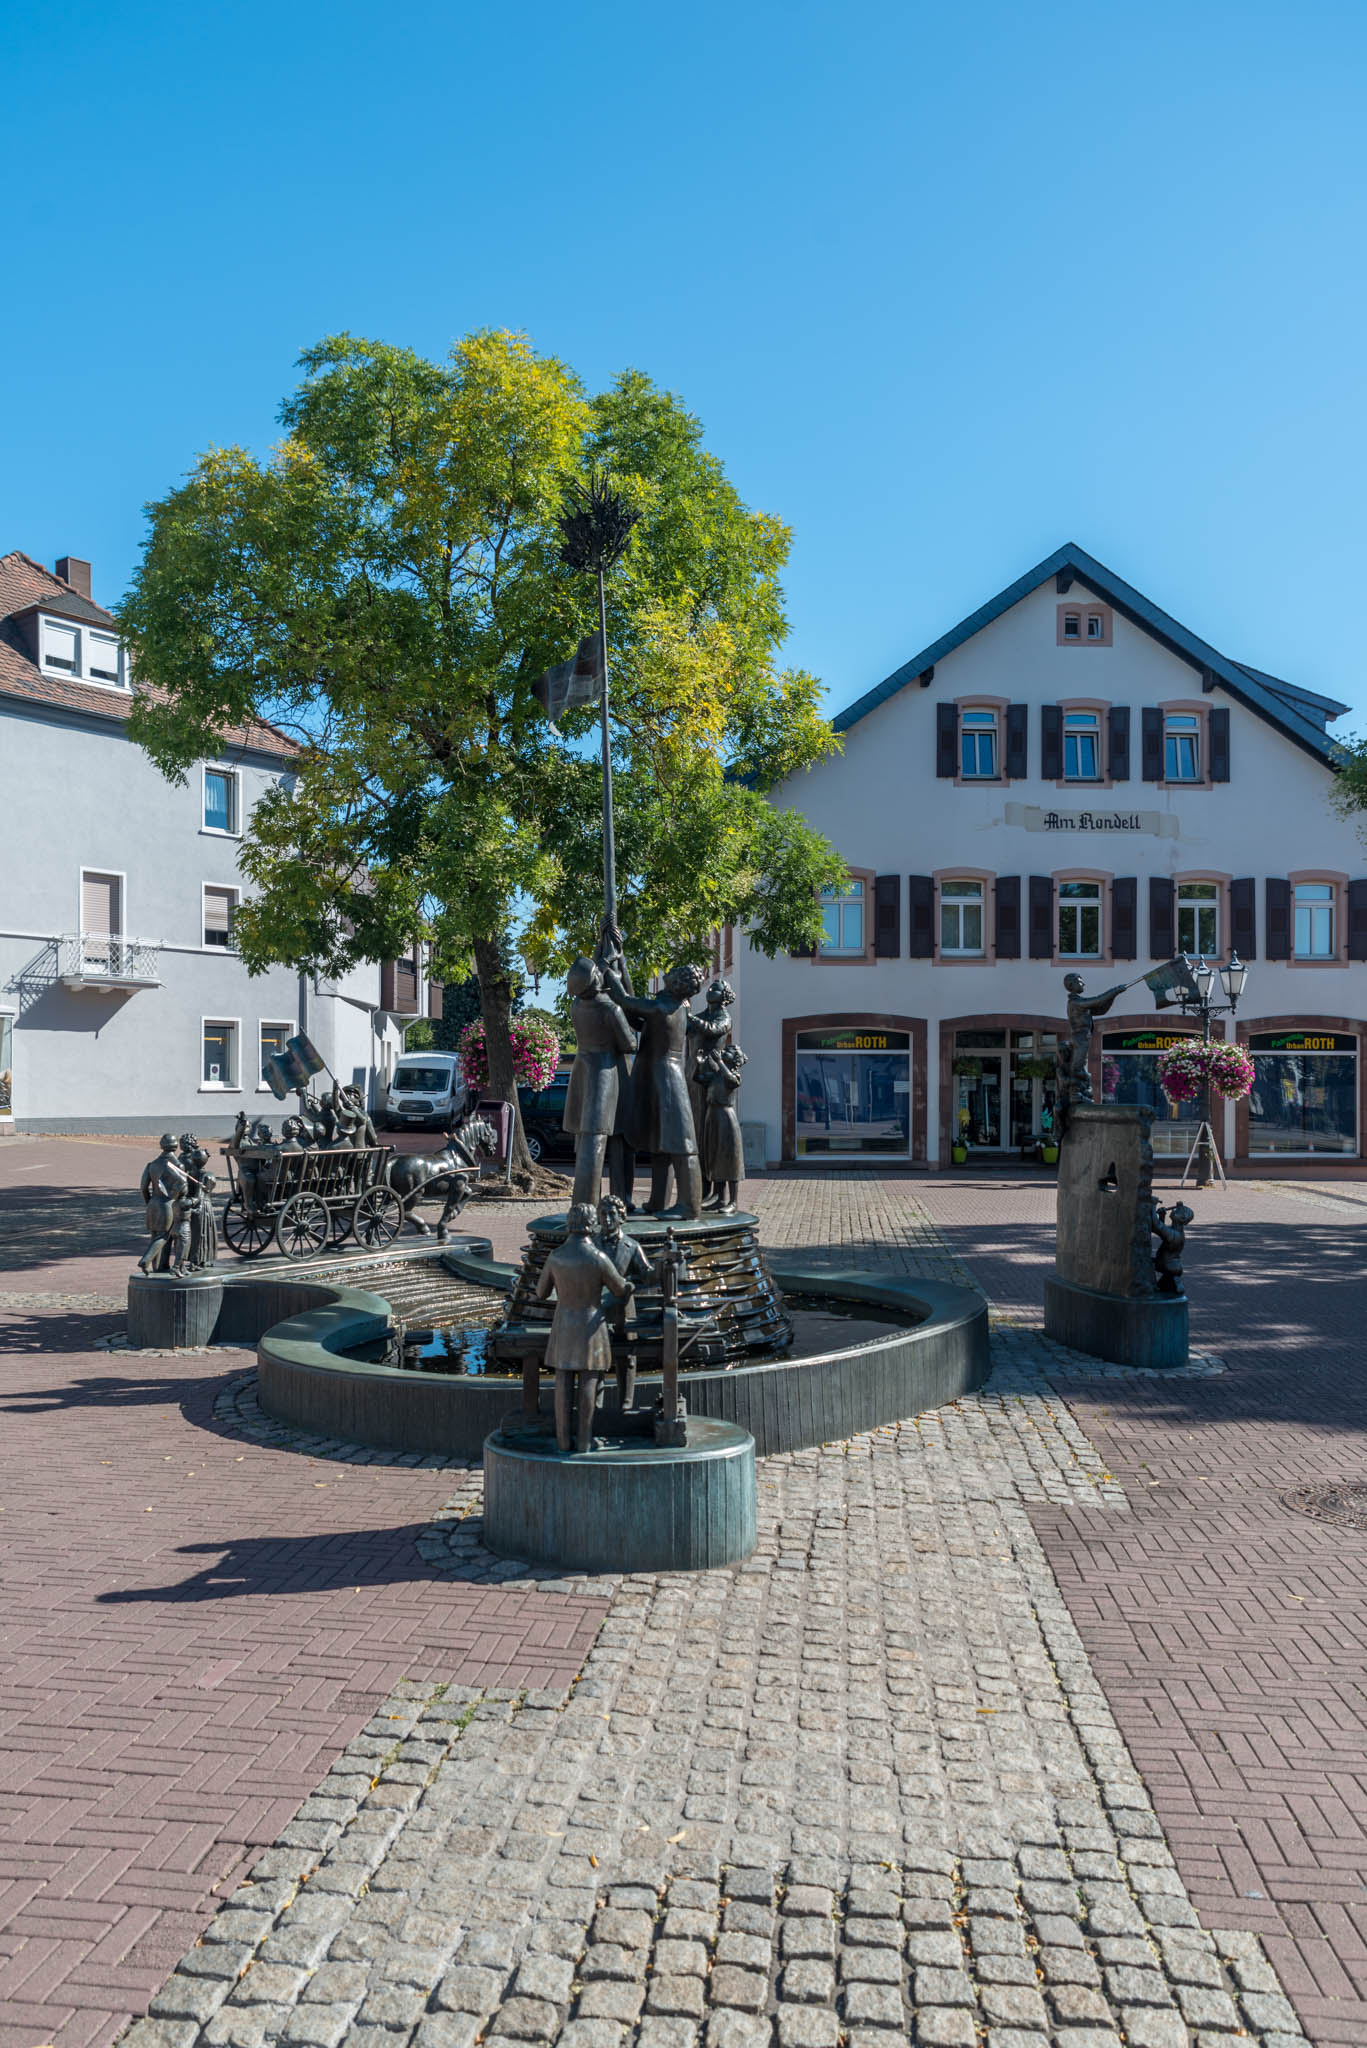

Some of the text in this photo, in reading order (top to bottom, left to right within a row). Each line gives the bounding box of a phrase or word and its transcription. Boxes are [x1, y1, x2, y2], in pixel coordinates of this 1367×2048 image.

[1044, 812, 1141, 831] Am Rondell
[855, 1036, 887, 1048] ROTH
[1155, 1037, 1185, 1048] ROT
[1304, 1037, 1335, 1049] ROTH
